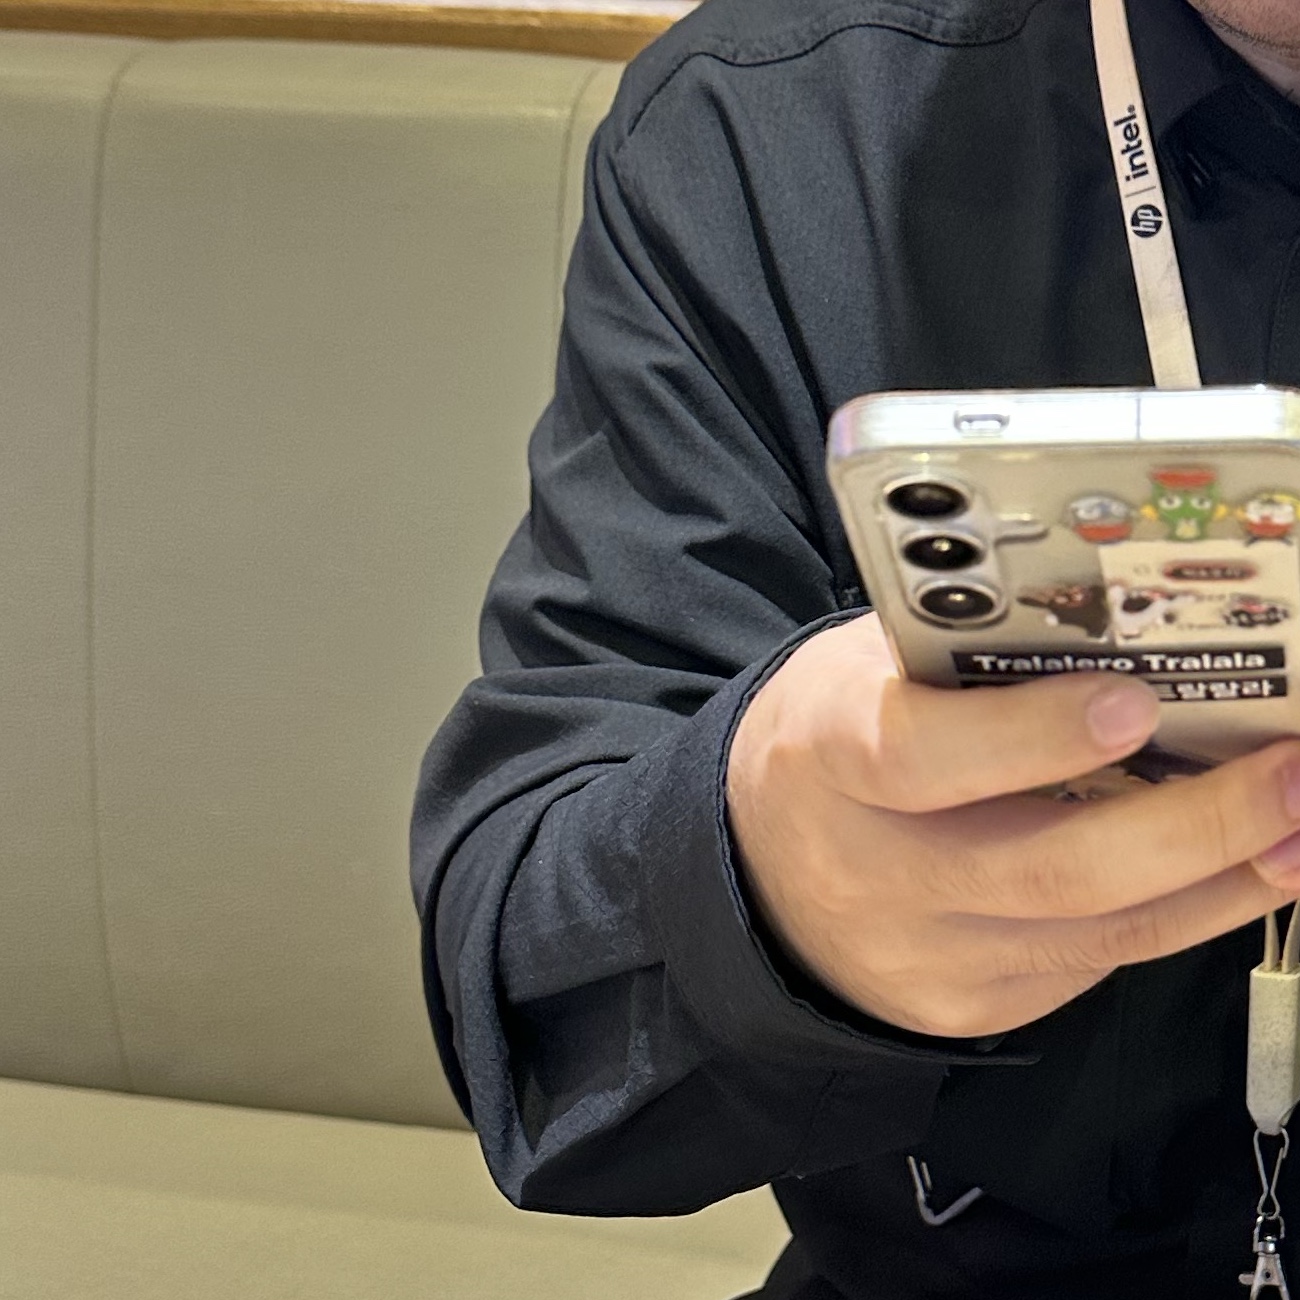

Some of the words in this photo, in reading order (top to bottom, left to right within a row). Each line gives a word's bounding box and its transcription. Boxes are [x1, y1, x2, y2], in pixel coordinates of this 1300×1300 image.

[1131, 204, 1163, 238] hp
[972, 654, 1135, 673] Tralalero
[1142, 652, 1268, 671] Tralala
